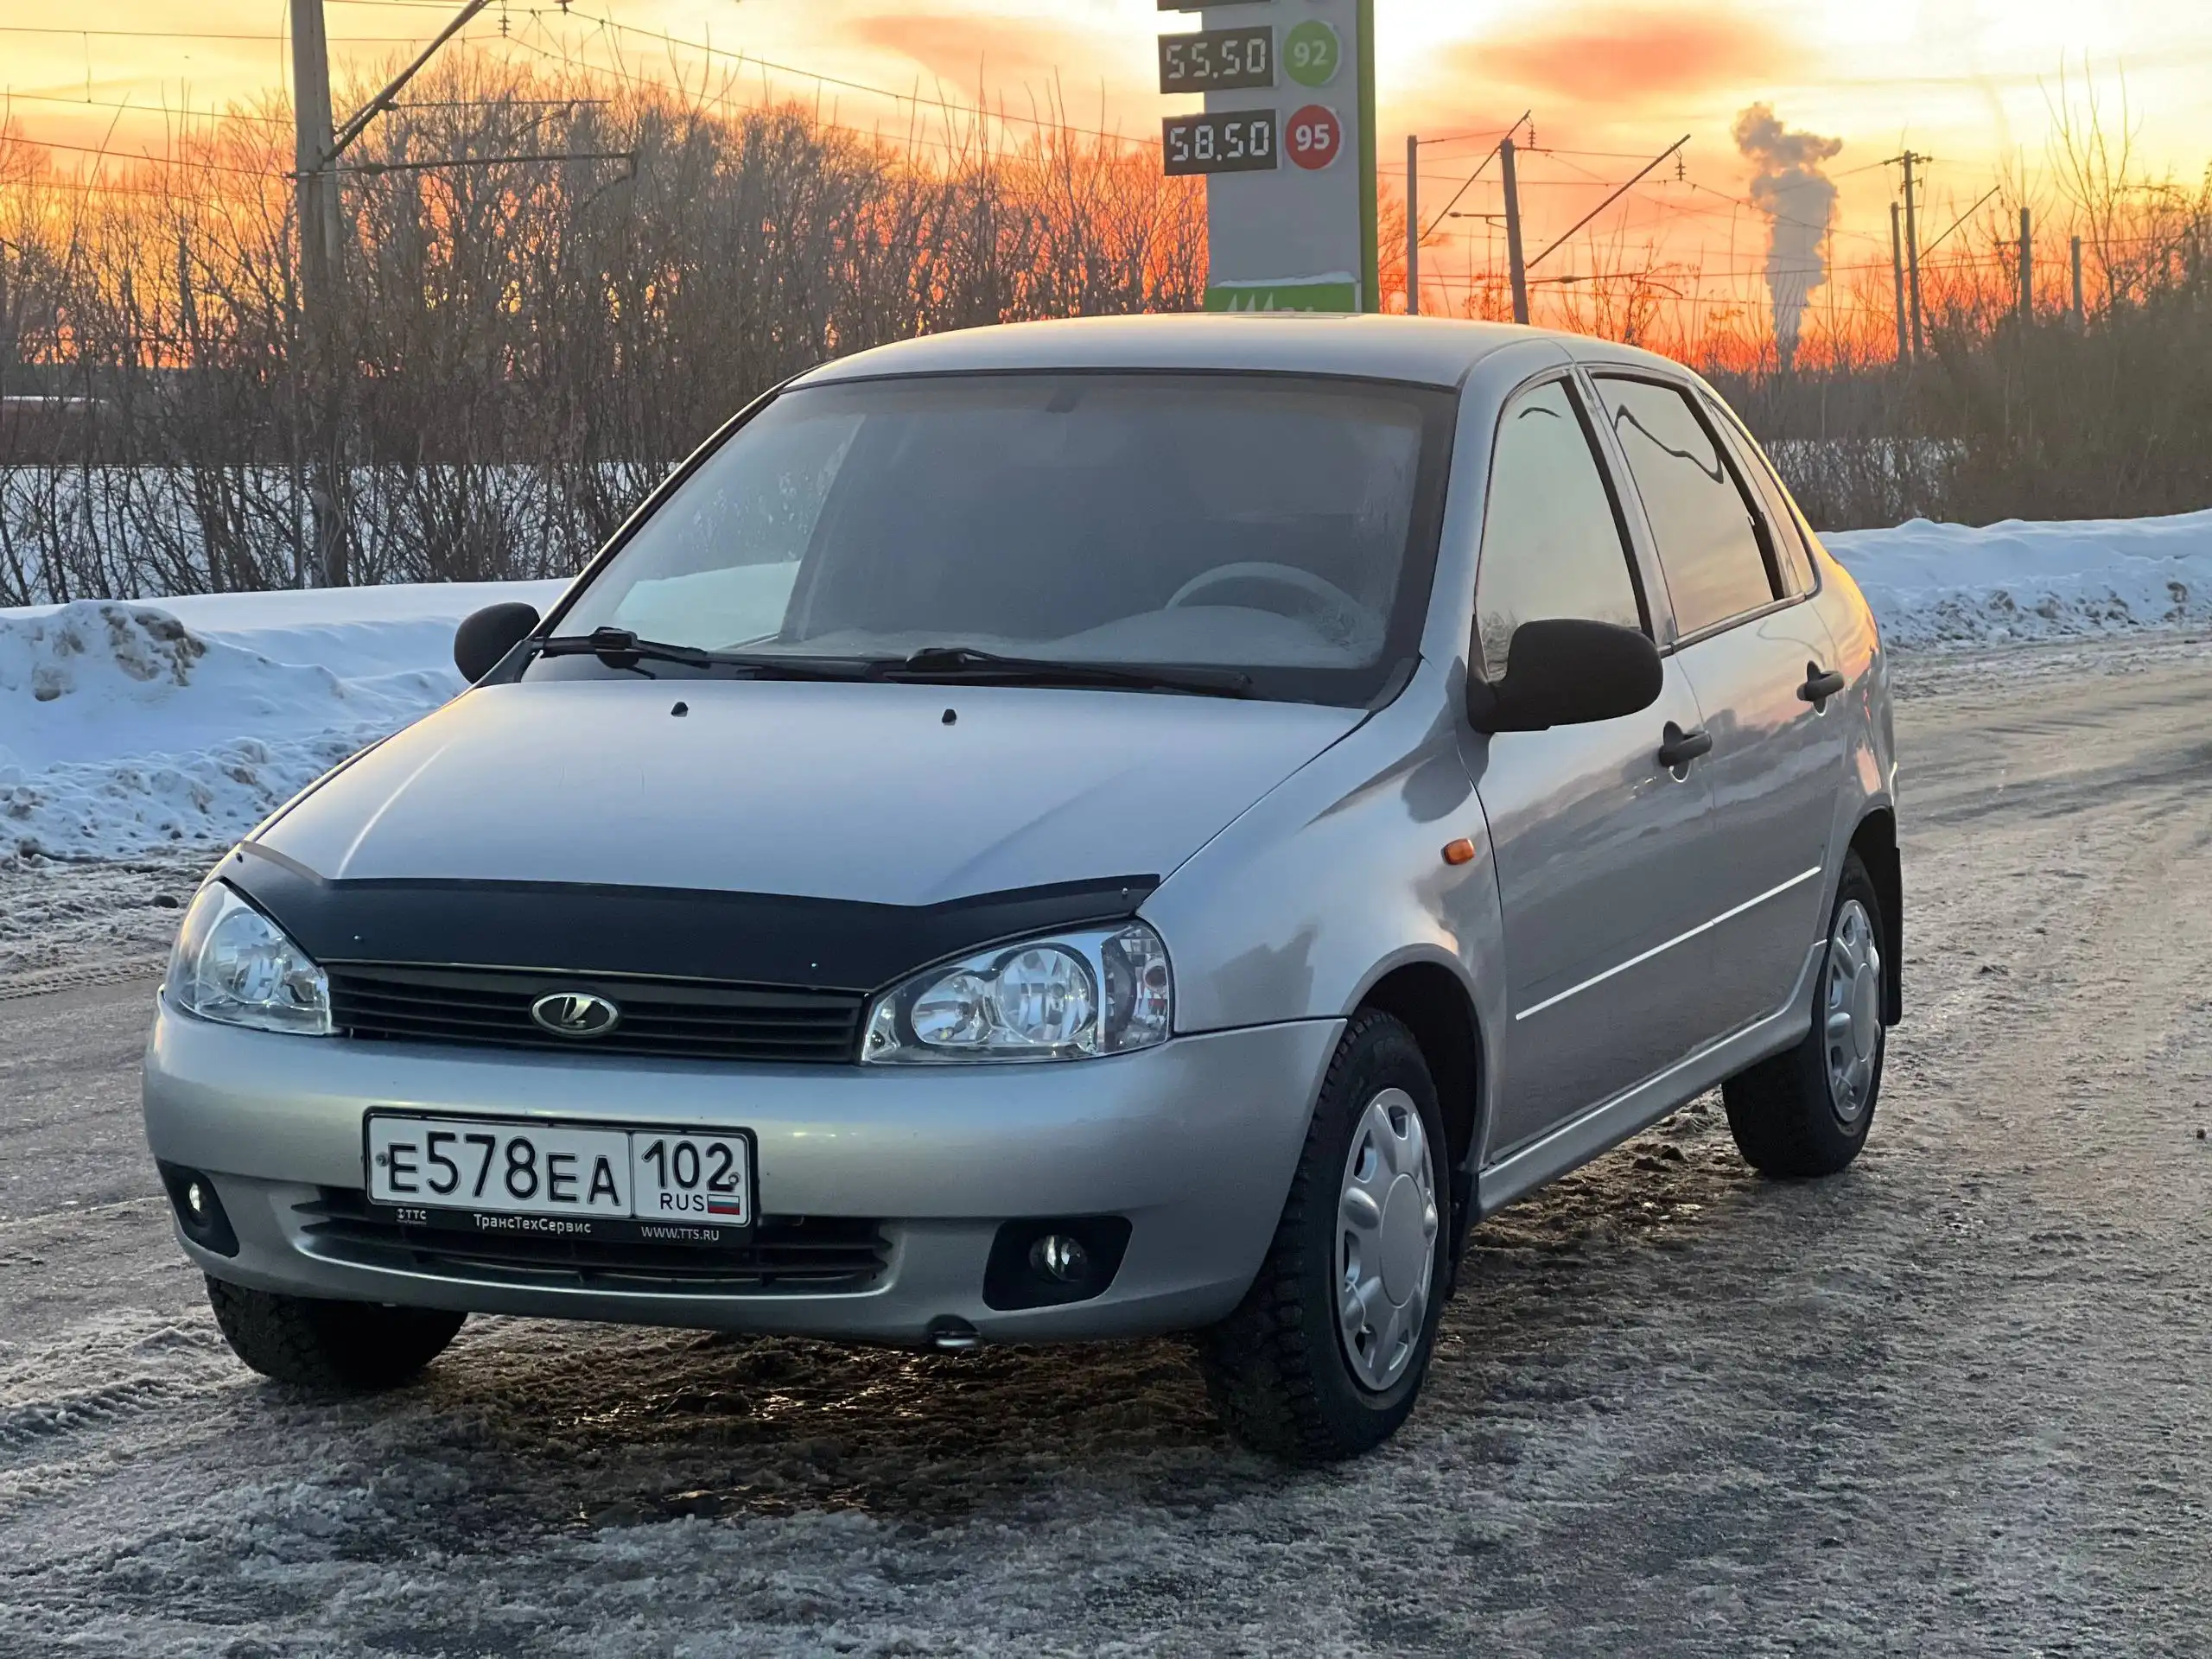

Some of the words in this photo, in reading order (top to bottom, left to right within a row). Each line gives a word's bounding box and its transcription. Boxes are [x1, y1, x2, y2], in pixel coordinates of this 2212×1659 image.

[1166, 39, 1266, 79] 55.50
[1294, 41, 1329, 67] 92
[1170, 121, 1269, 162] 58.50
[1296, 124, 1330, 150] 95
[641, 1140, 734, 1192] 102
[660, 1192, 704, 1211] RUS
[474, 1213, 592, 1235] ТрансТехСервис
[641, 1225, 720, 1241] WWW.TTS.RU
